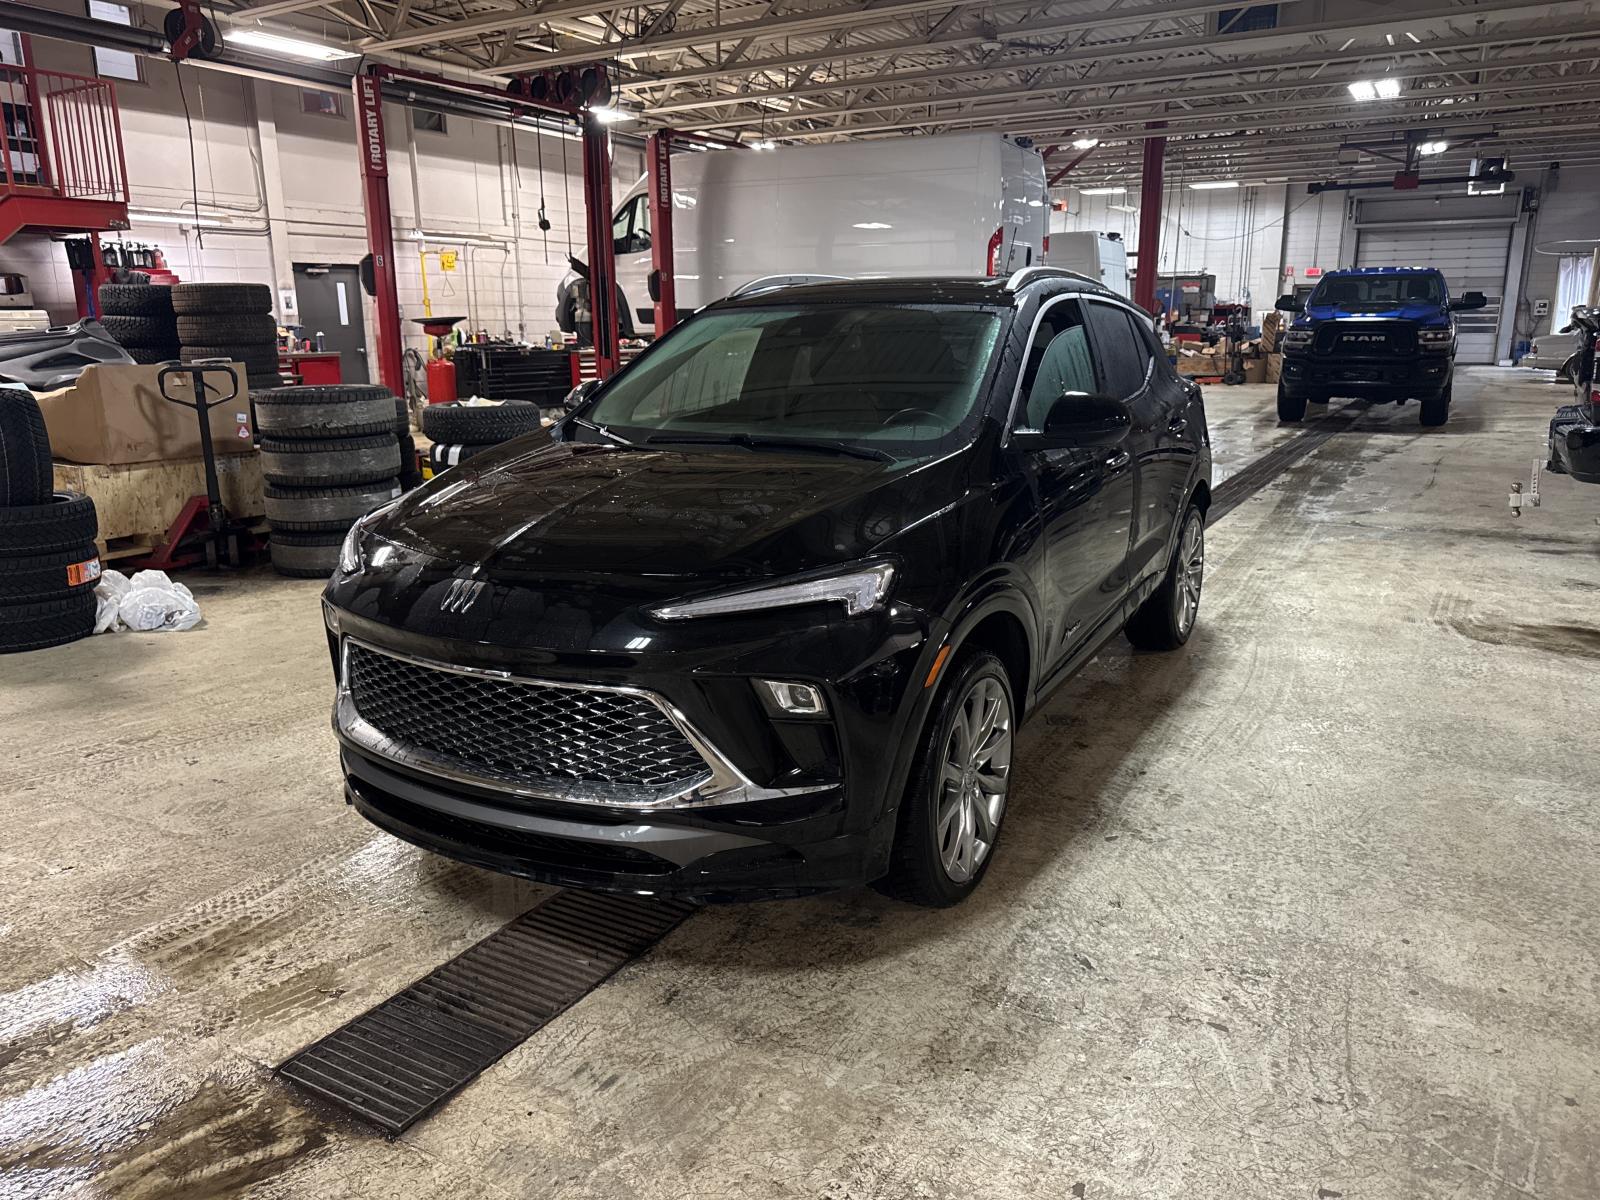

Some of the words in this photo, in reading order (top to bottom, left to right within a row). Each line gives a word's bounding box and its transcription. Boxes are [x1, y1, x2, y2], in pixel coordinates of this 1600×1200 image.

[363, 77, 376, 106] LIFT
[366, 109, 382, 164] ROTARY
[659, 138, 667, 160] LIFT
[660, 162, 669, 203] ROTARY
